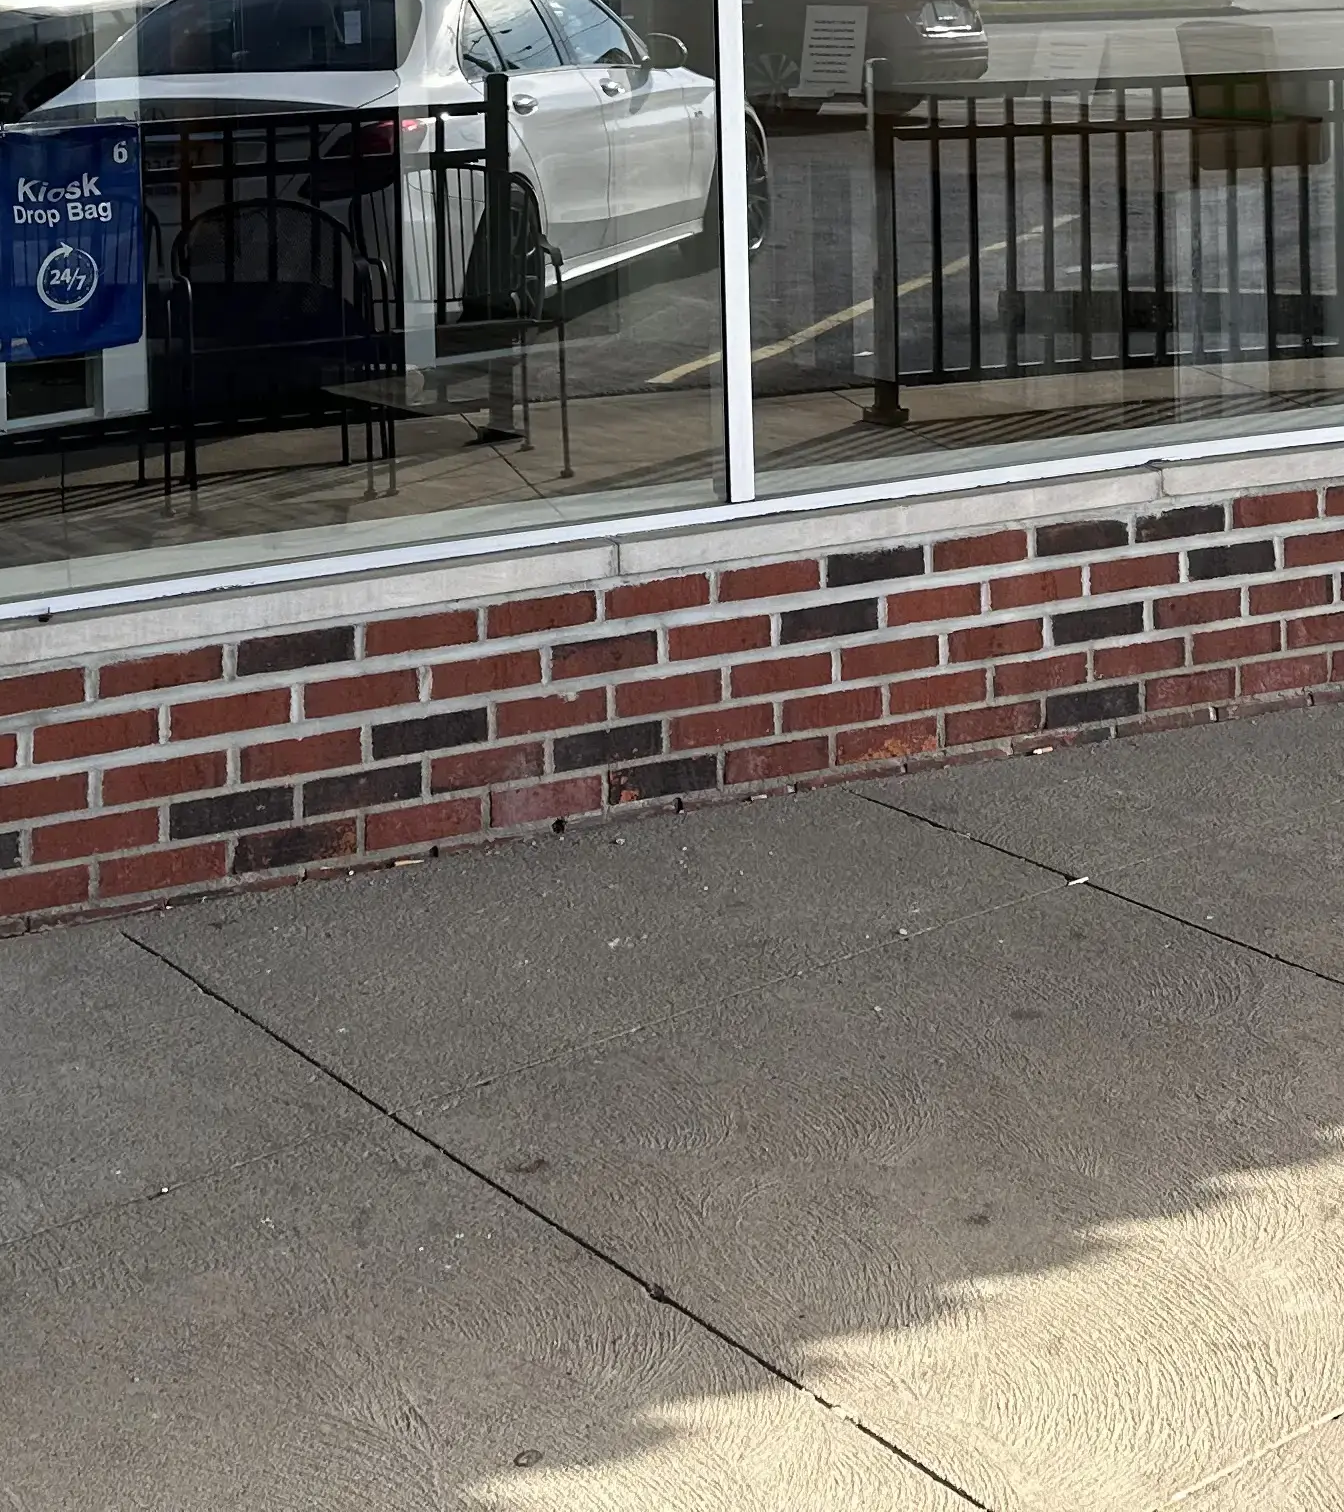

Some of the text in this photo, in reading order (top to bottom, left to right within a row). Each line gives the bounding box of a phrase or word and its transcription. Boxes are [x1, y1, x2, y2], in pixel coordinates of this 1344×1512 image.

[113, 141, 128, 163] 6
[17, 172, 102, 203] Kiosk
[13, 201, 113, 227] Drop Bag
[49, 267, 87, 291] 24/7
